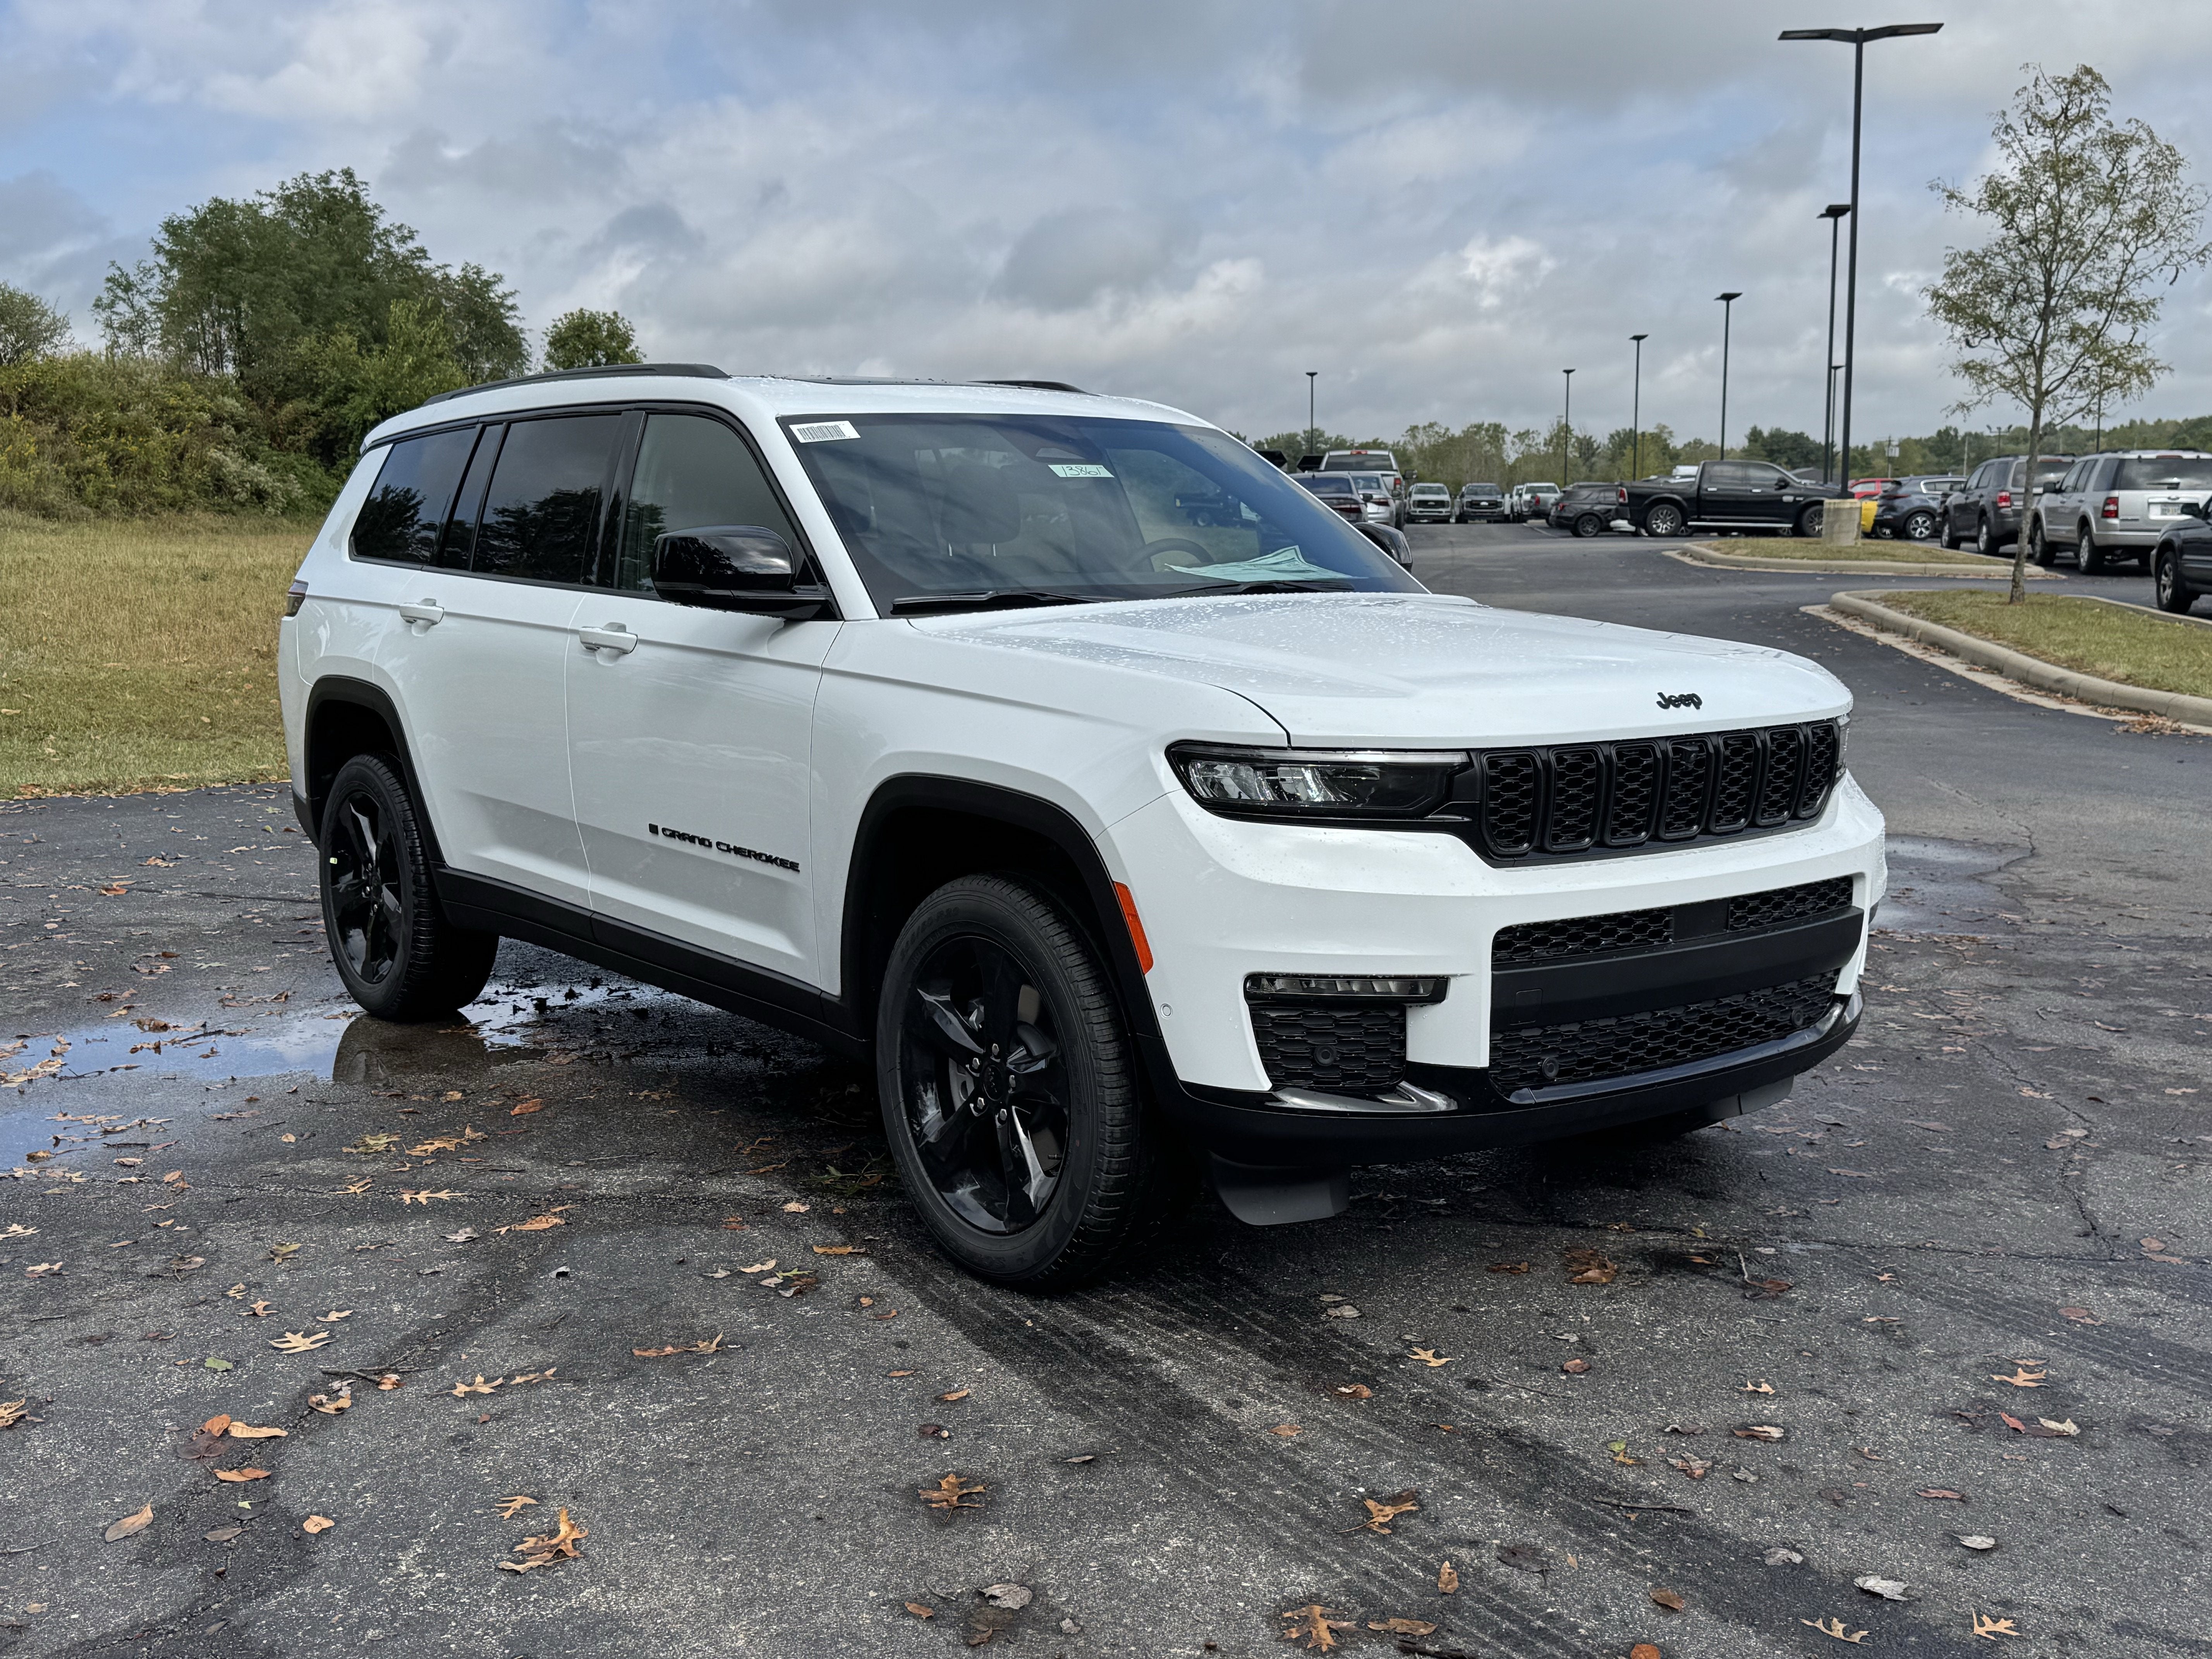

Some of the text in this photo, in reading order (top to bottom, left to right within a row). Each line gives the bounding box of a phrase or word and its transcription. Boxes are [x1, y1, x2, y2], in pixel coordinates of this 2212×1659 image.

[1061, 466, 1101, 477] 13861
[1656, 692, 1703, 709] Jeep
[661, 827, 800, 872] GRAND CHEROKEE
